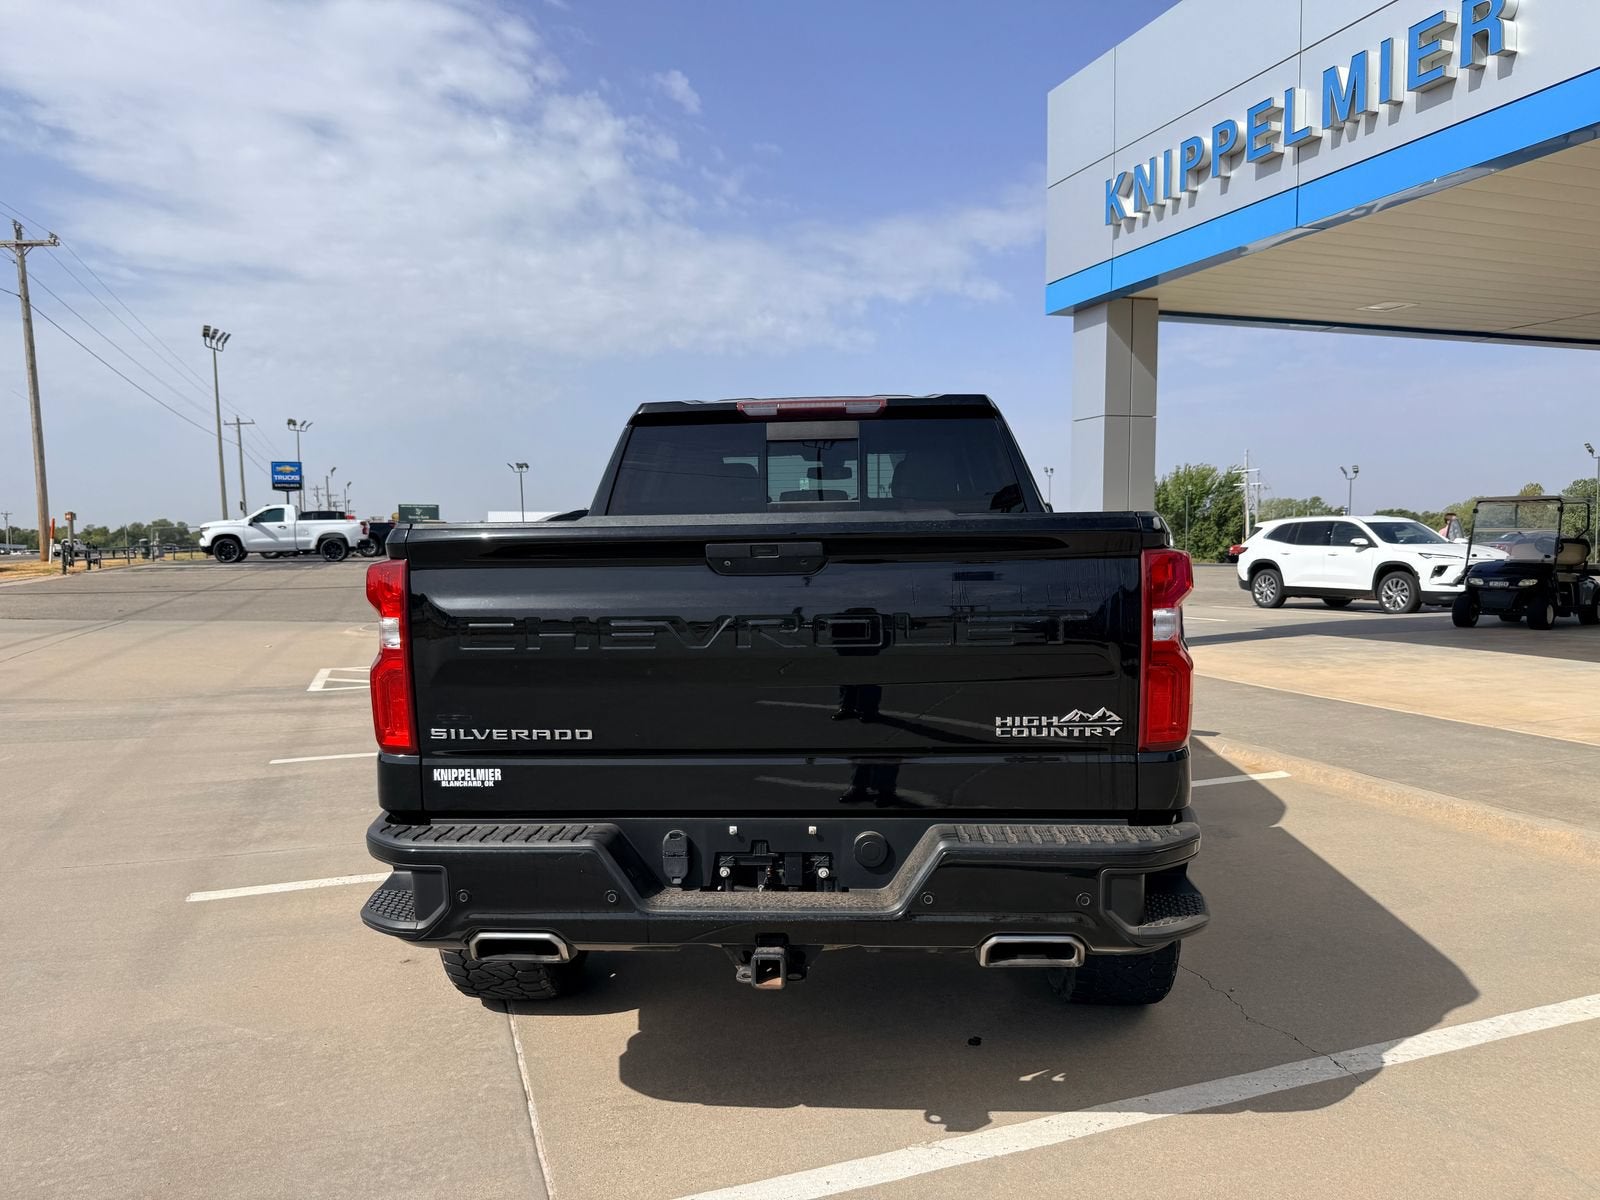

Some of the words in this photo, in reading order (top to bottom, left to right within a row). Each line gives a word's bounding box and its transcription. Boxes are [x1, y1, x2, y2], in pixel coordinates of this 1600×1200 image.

[1104, 0, 1517, 226] KNIPPELMIER
[458, 615, 1090, 650] CHEVROLET
[995, 716, 1059, 727] HIGH
[430, 727, 593, 741] SILVERADO
[995, 726, 1122, 738] COUNTRY
[433, 768, 502, 781] KNIPPELMIER
